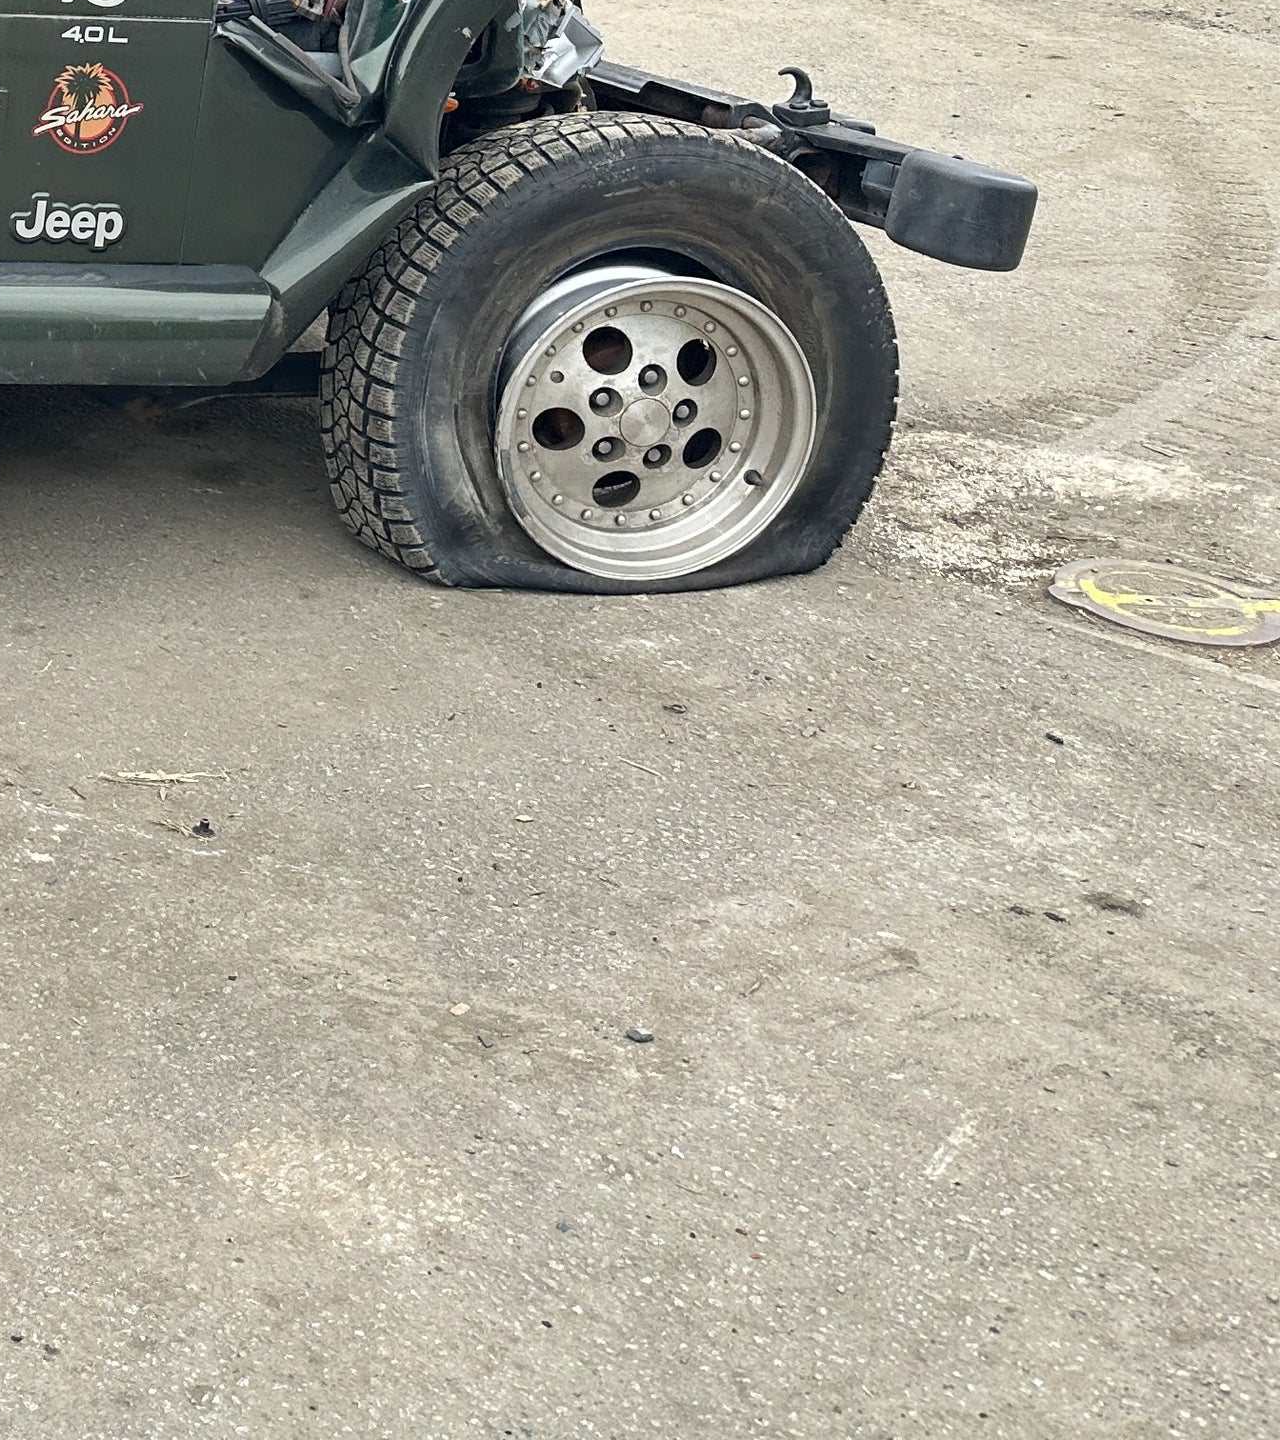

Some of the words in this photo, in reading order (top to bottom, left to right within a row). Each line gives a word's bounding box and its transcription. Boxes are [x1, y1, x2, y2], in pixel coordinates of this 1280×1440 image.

[33, 98, 142, 135] Sahara
[56, 126, 117, 149] EDITION
[13, 197, 125, 249] Jeep
